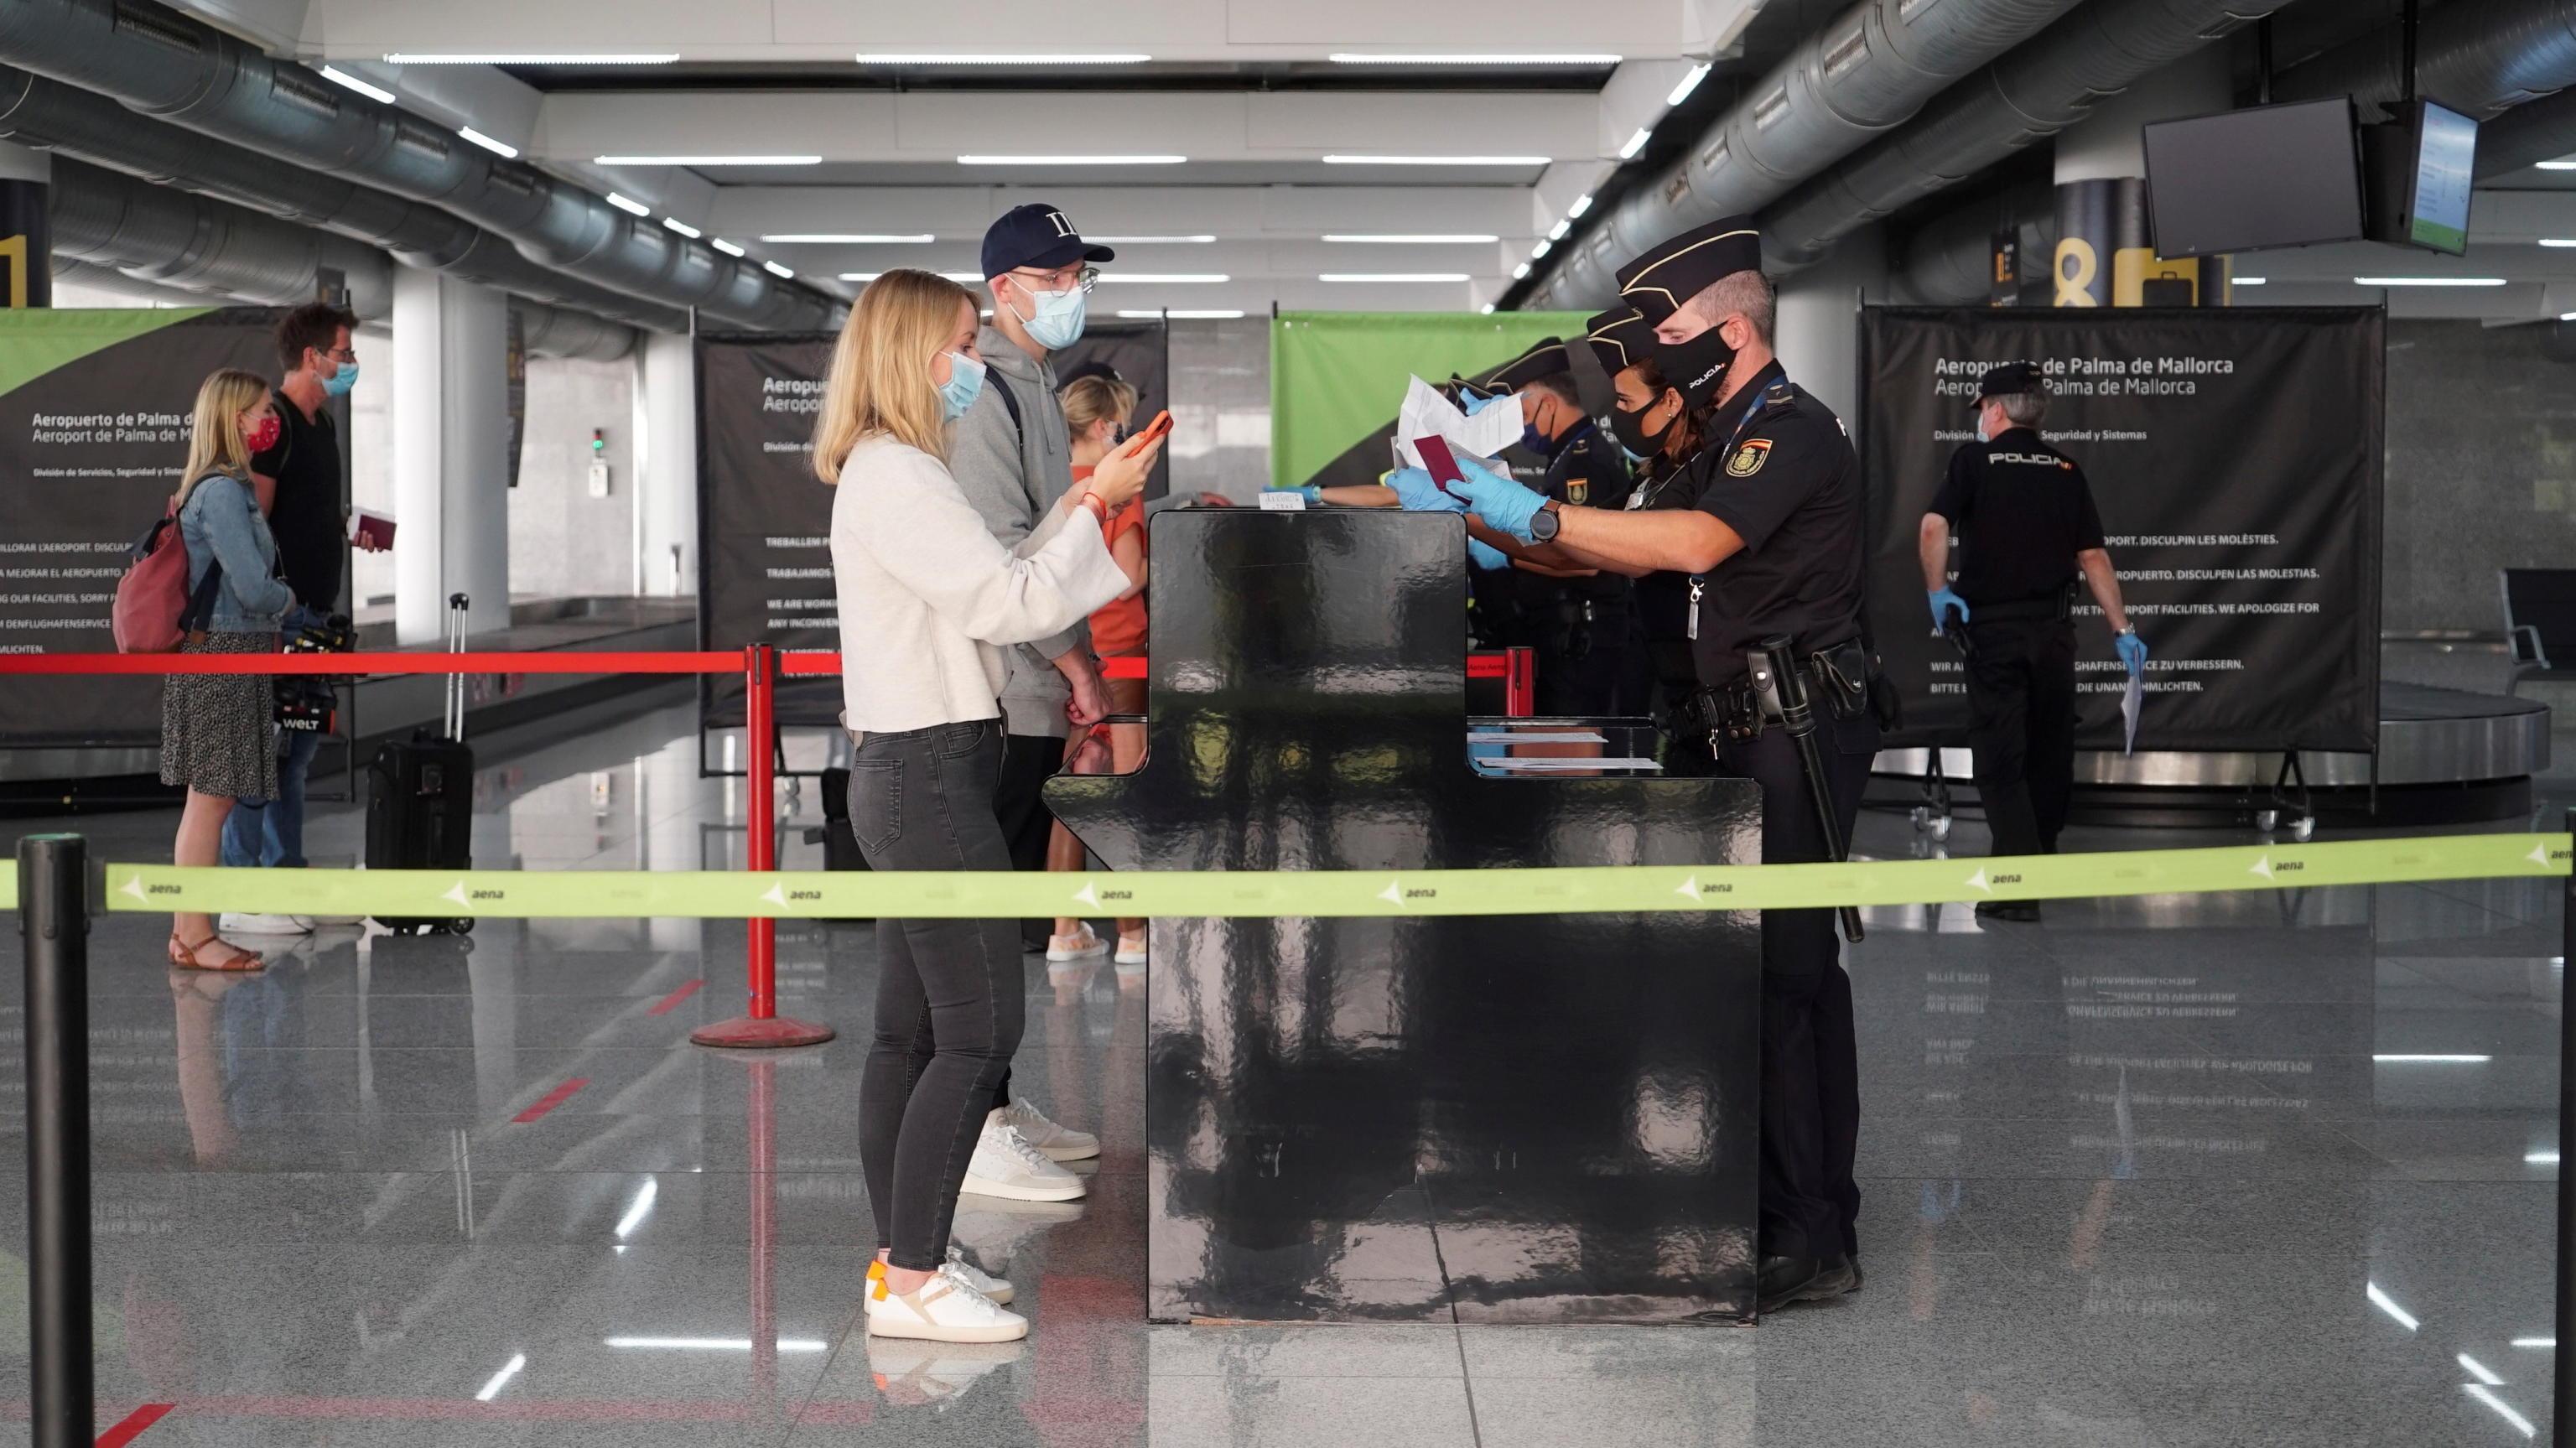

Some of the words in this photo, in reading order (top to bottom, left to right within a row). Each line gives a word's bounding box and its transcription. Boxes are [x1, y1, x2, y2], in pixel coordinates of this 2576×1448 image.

[2044, 357, 2065, 374] de
[2070, 356, 2126, 374] Palma
[2132, 357, 2153, 374] de
[2158, 356, 2233, 374] Mallorca
[1689, 364, 1722, 389] POLICIA
[1935, 379, 1983, 398] Aerop
[2044, 379, 2093, 395] Palma
[2099, 379, 2120, 395] de
[2125, 378, 2195, 395] Mallorca
[32, 413, 112, 428] Aeropuerto
[117, 412, 134, 427] de
[138, 412, 180, 426] Palma
[184, 412, 194, 426] d
[32, 428, 91, 445] Aeroport
[96, 428, 112, 443] de
[116, 428, 156, 443] Palma
[159, 428, 177, 443] de
[1934, 429, 1974, 441] División
[2041, 429, 2091, 443] Seguridad
[2095, 433, 2101, 443] y
[2102, 429, 2148, 441] Sistemas
[1988, 453, 2060, 465] POLICIA
[34, 467, 65, 477] División
[65, 467, 76, 477] de
[77, 467, 115, 478] Servicios,
[116, 467, 156, 478] Seguridad
[157, 470, 162, 478] y
[1512, 467, 1534, 477] vicios,
[2141, 535, 2195, 546] DISCULPIN
[2198, 535, 2216, 546] LES
[2219, 533, 2279, 546] MOLÈSTIES.
[6, 568, 49, 578] MEJORAR
[50, 568, 60, 578] EL
[62, 568, 122, 579] AEROPUERTO.
[2116, 569, 2175, 580] ROPUERTO.
[2177, 569, 2234, 580] DISCULPEN
[2236, 568, 2256, 579] LAS
[2258, 568, 2319, 579] MOLESTIAS.
[10, 594, 30, 604] OUR
[32, 593, 79, 605] FACILITIES,
[80, 593, 108, 603] SORRY
[767, 599, 782, 610] WE
[2126, 605, 2160, 615] RPORT
[2162, 604, 2217, 615] FACILITIES.
[2220, 604, 2235, 614] WE
[2238, 603, 2296, 614] APOLOGIZE
[2298, 603, 2319, 614] FOR
[789, 617, 839, 629] INCONVEN
[1930, 662, 1951, 672] WIR
[2160, 660, 2174, 671] ZU
[2176, 659, 2244, 671] VERBESSERN.
[1930, 682, 1961, 693] BITTE
[2077, 682, 2093, 693] DIE
[2551, 849, 2572, 859] aen
[2276, 861, 2304, 871] aena
[1993, 874, 2022, 884] aena
[148, 884, 182, 895] aena
[1406, 887, 1436, 898] aena
[1702, 883, 1732, 893] aena
[472, 890, 504, 899] aena
[790, 890, 822, 900] aena
[1102, 890, 1132, 900] aena
